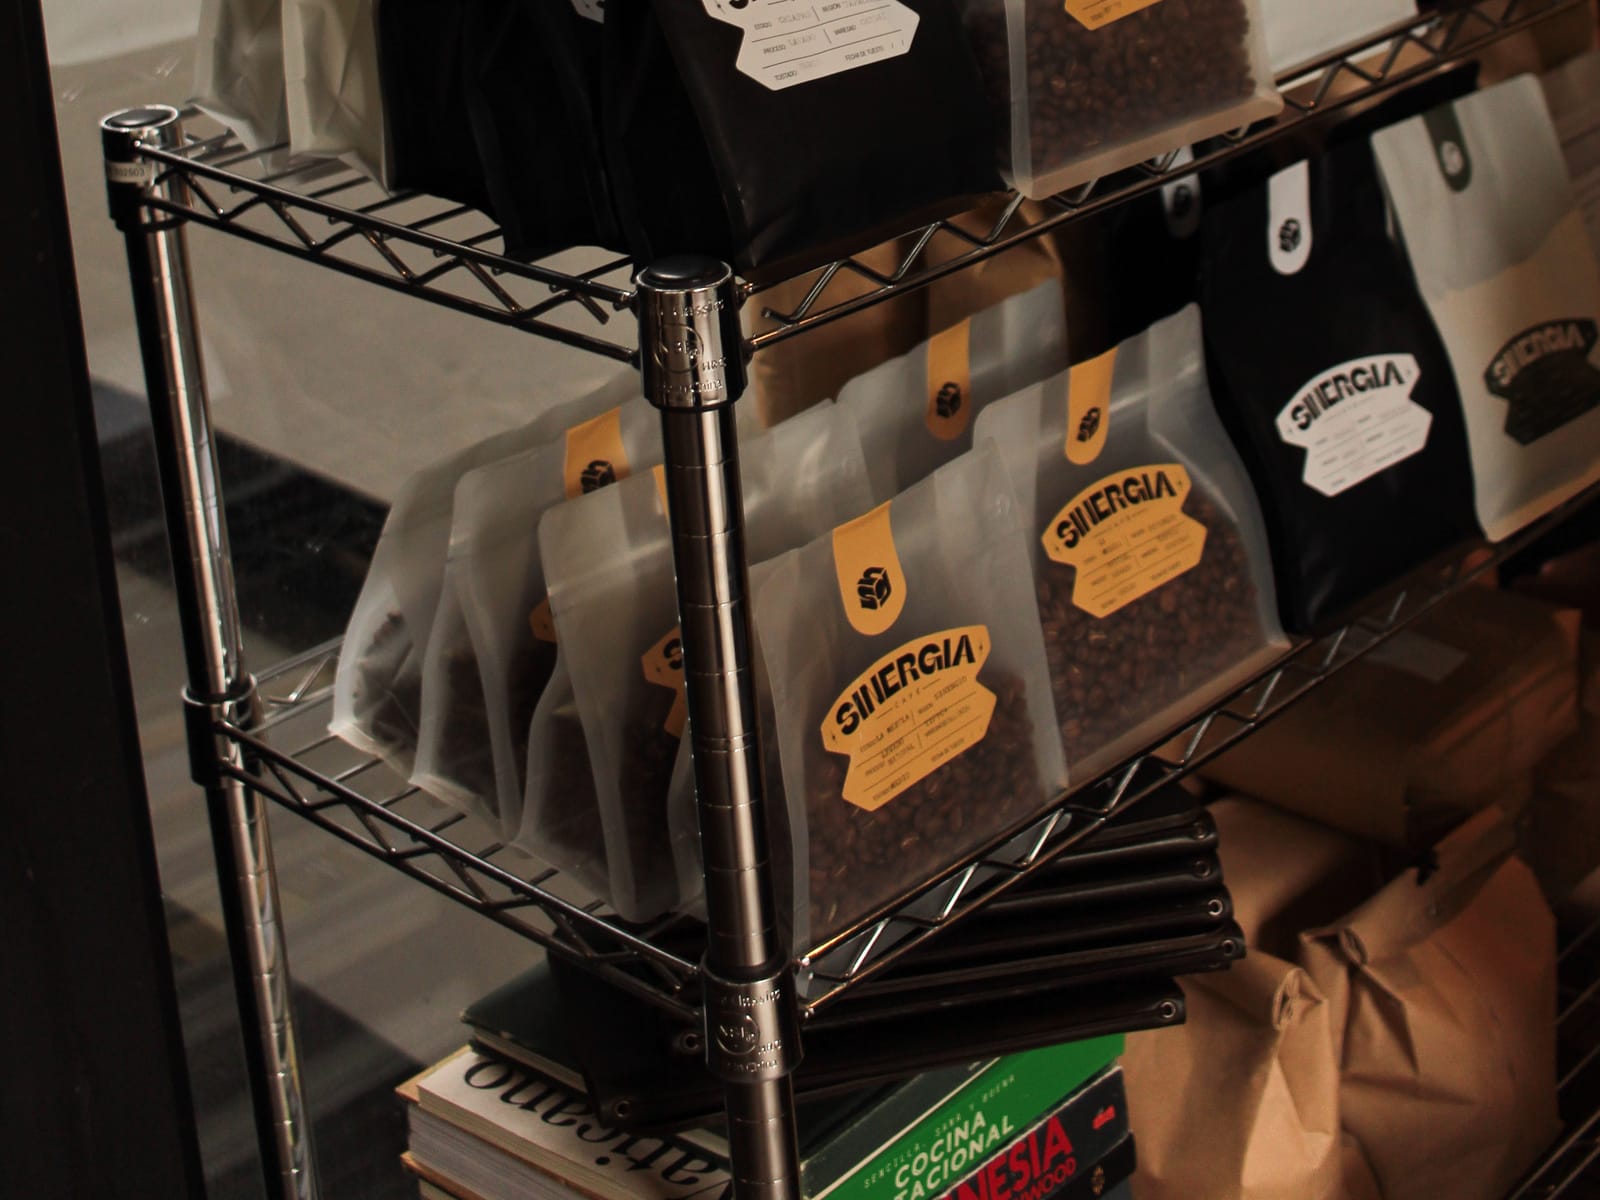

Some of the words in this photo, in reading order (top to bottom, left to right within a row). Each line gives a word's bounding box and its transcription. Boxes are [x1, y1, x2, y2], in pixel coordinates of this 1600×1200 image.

[1291, 360, 1405, 431] SINERGIA
[1057, 471, 1177, 549] SINERGIA
[836, 634, 976, 736] SINERGIA
[895, 1111, 987, 1189] COCINA
